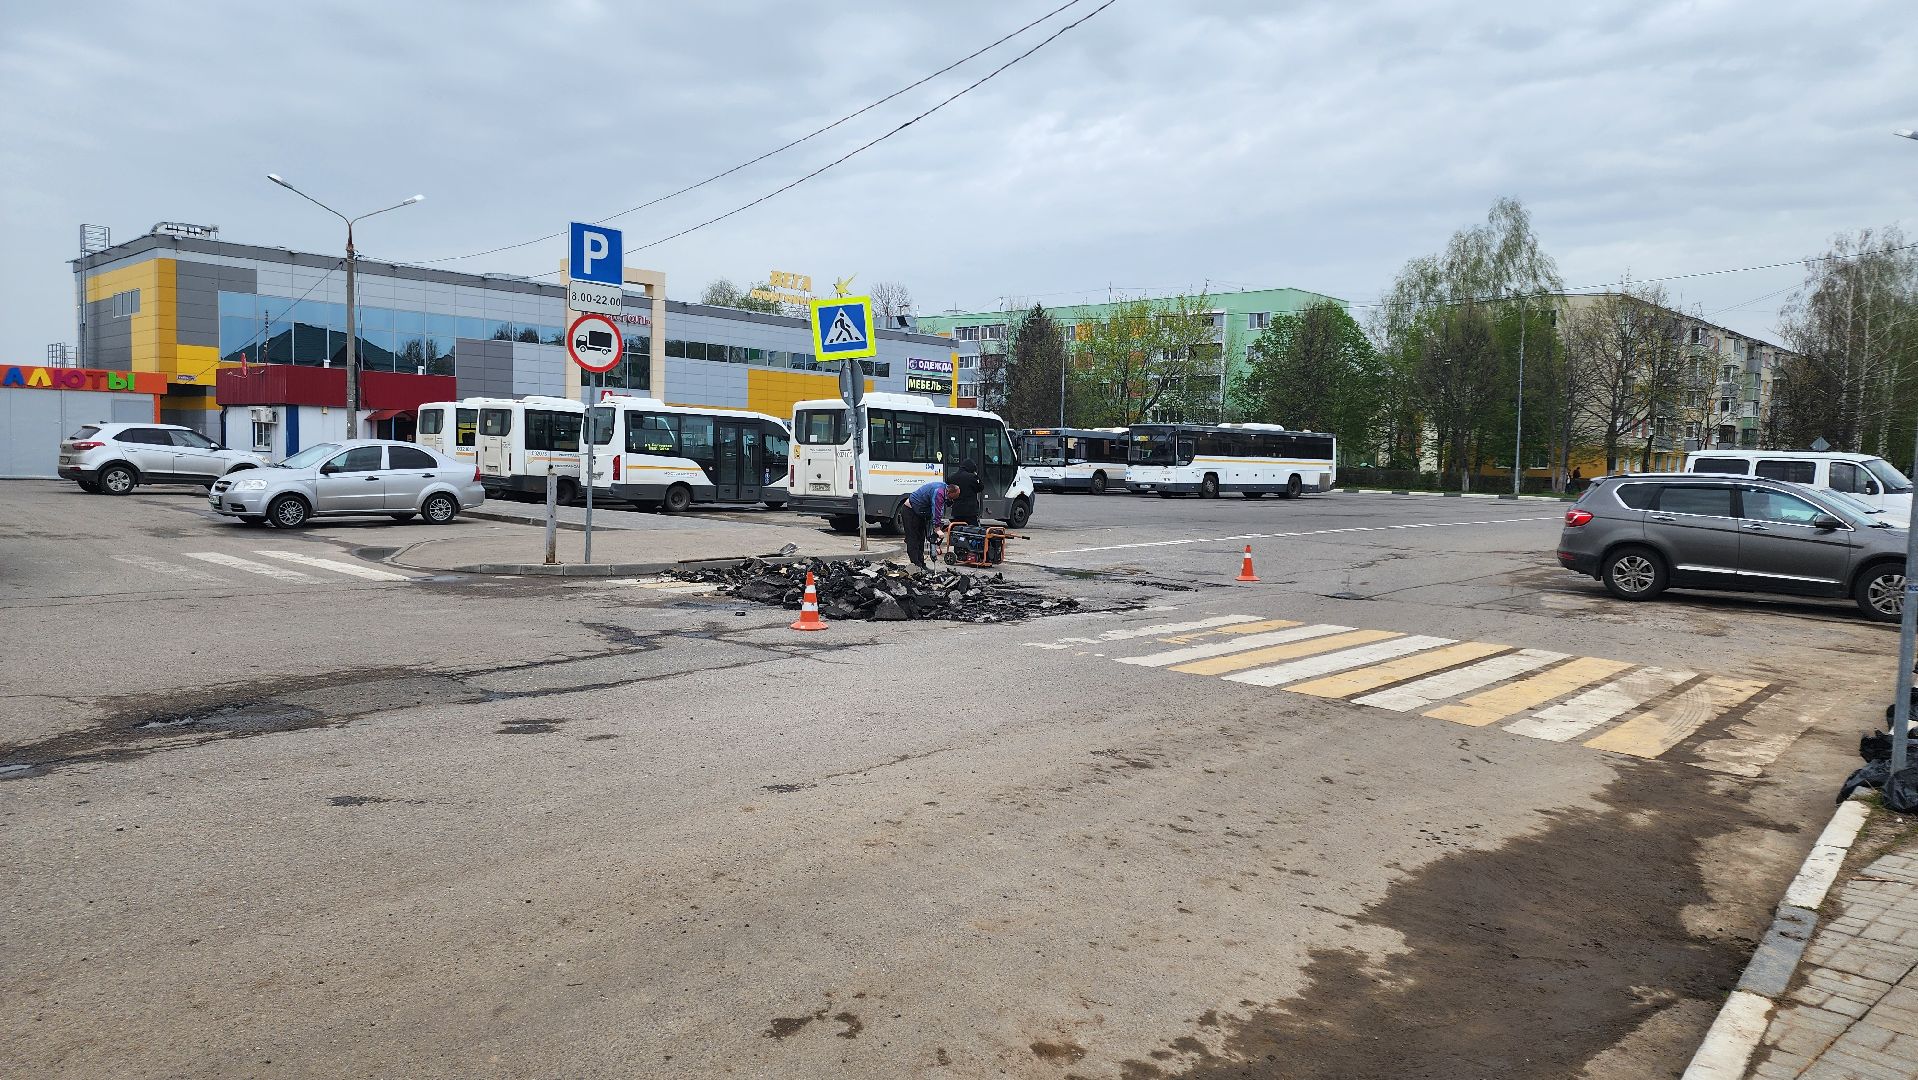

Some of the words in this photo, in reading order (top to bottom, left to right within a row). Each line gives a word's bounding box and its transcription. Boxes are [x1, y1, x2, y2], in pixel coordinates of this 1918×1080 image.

[769, 270, 812, 292] ВЕГА
[571, 291, 621, 307] 8.00-22.00
[918, 360, 953, 373] ОДЕЖДА
[2, 367, 136, 391] АЛЮТЫ
[908, 378, 942, 391] МЕБЕЛЬ
